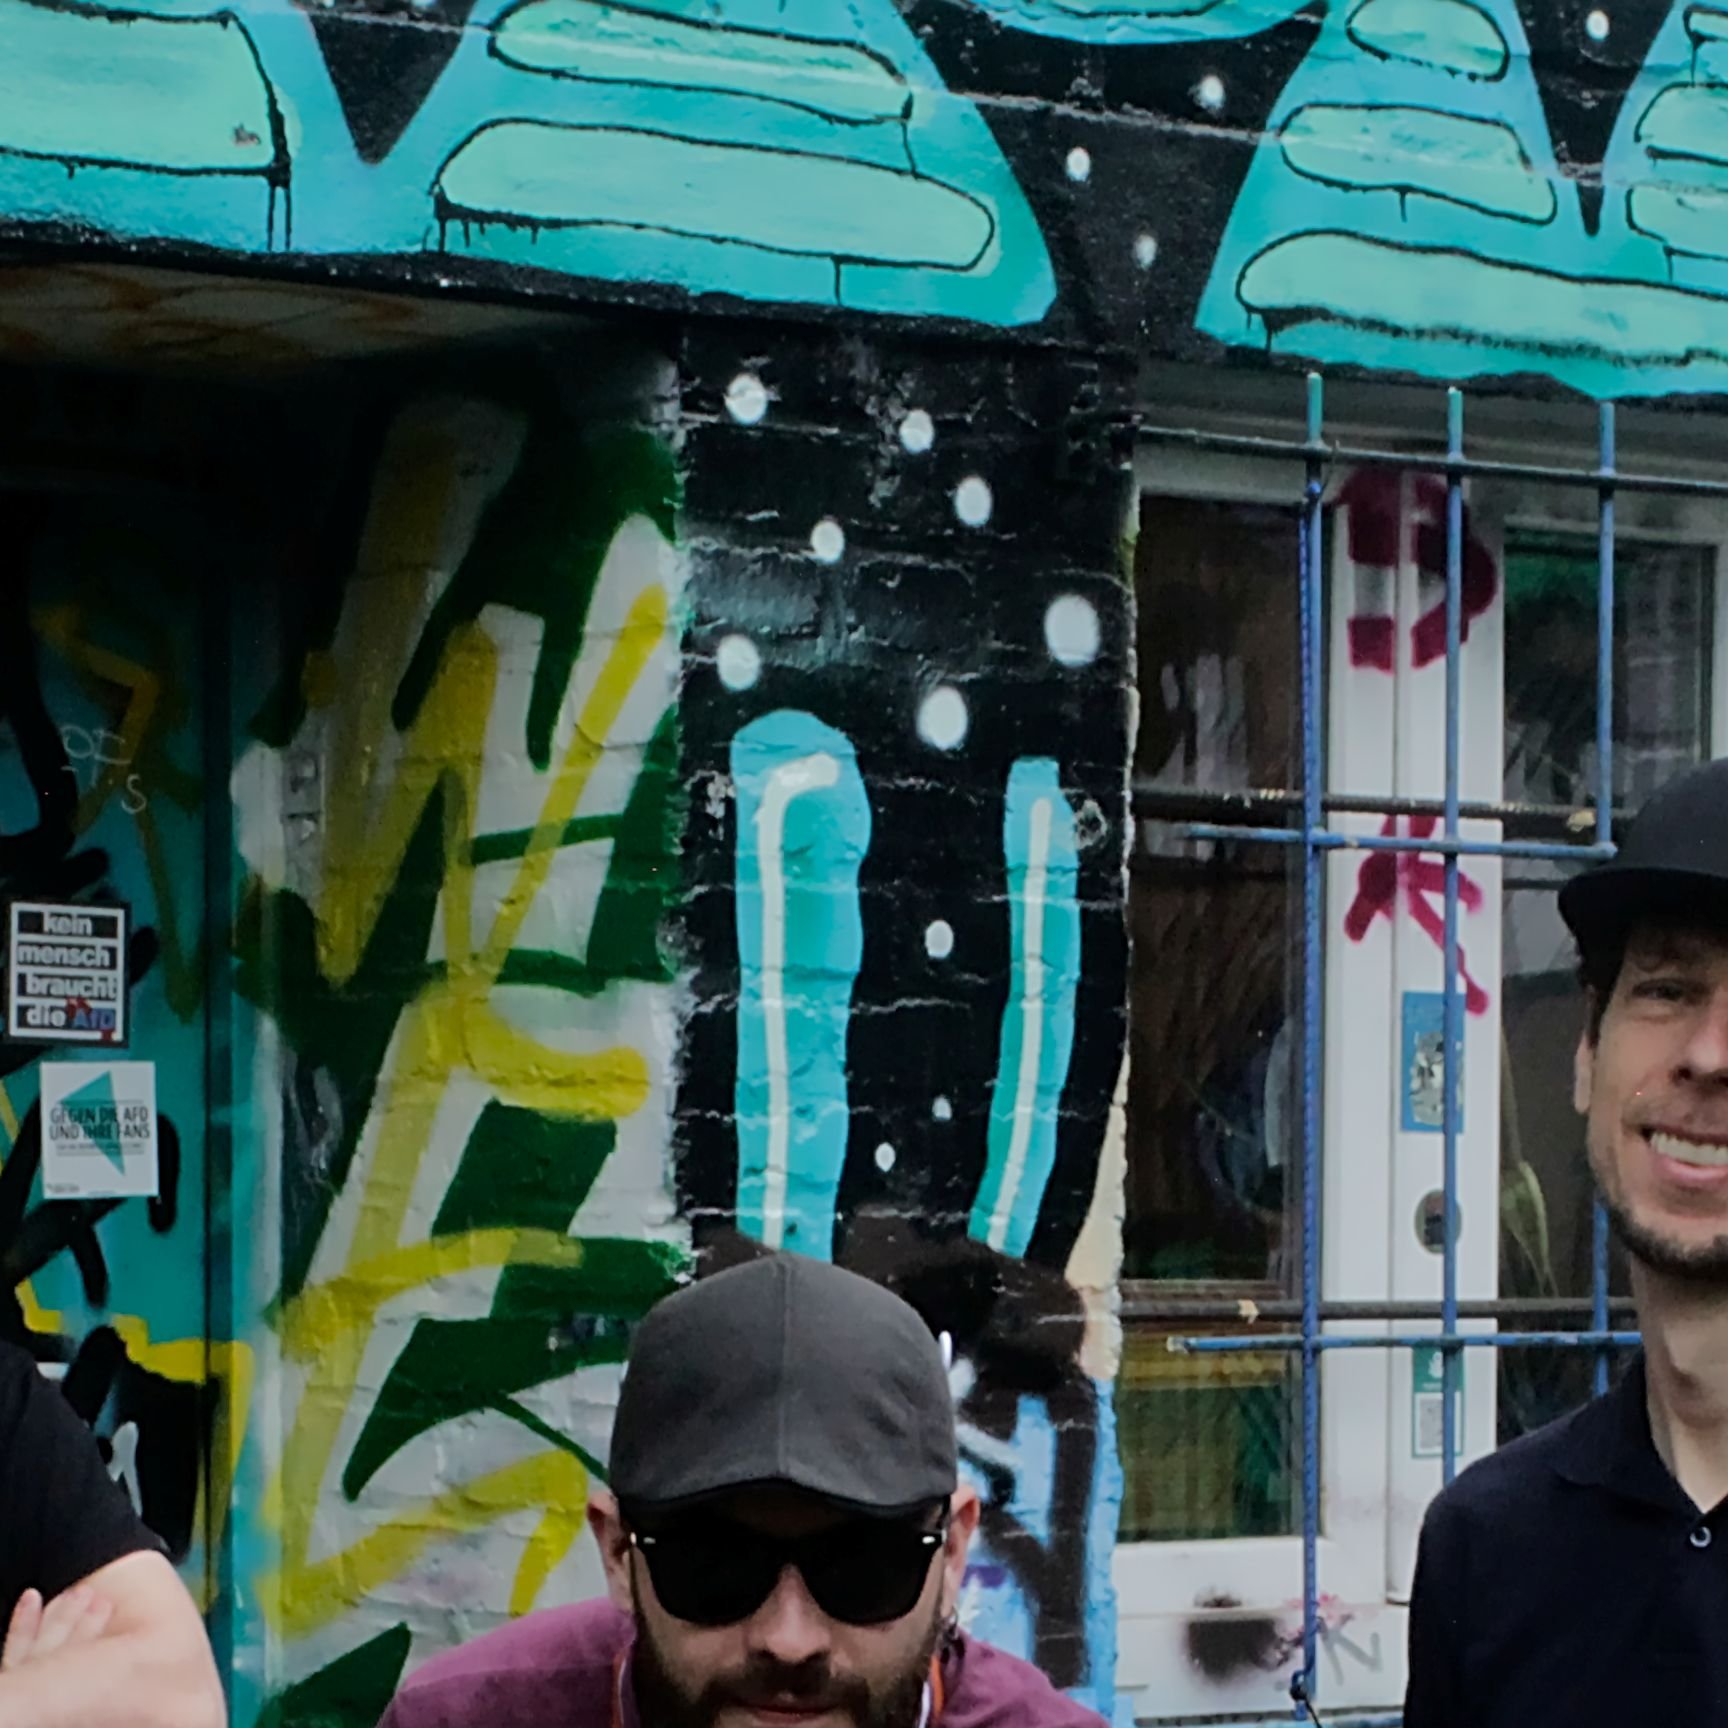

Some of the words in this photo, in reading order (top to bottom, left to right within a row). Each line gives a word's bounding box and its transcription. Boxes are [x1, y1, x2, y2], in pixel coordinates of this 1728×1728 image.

[43, 911, 93, 937] kein
[17, 942, 110, 968] mensch
[25, 973, 117, 1000] braucht
[26, 1005, 67, 1028] die
[50, 1106, 95, 1124] GEGEN
[123, 1106, 148, 1122] AFD
[49, 1124, 80, 1141] UND
[116, 1123, 151, 1141] FANS
